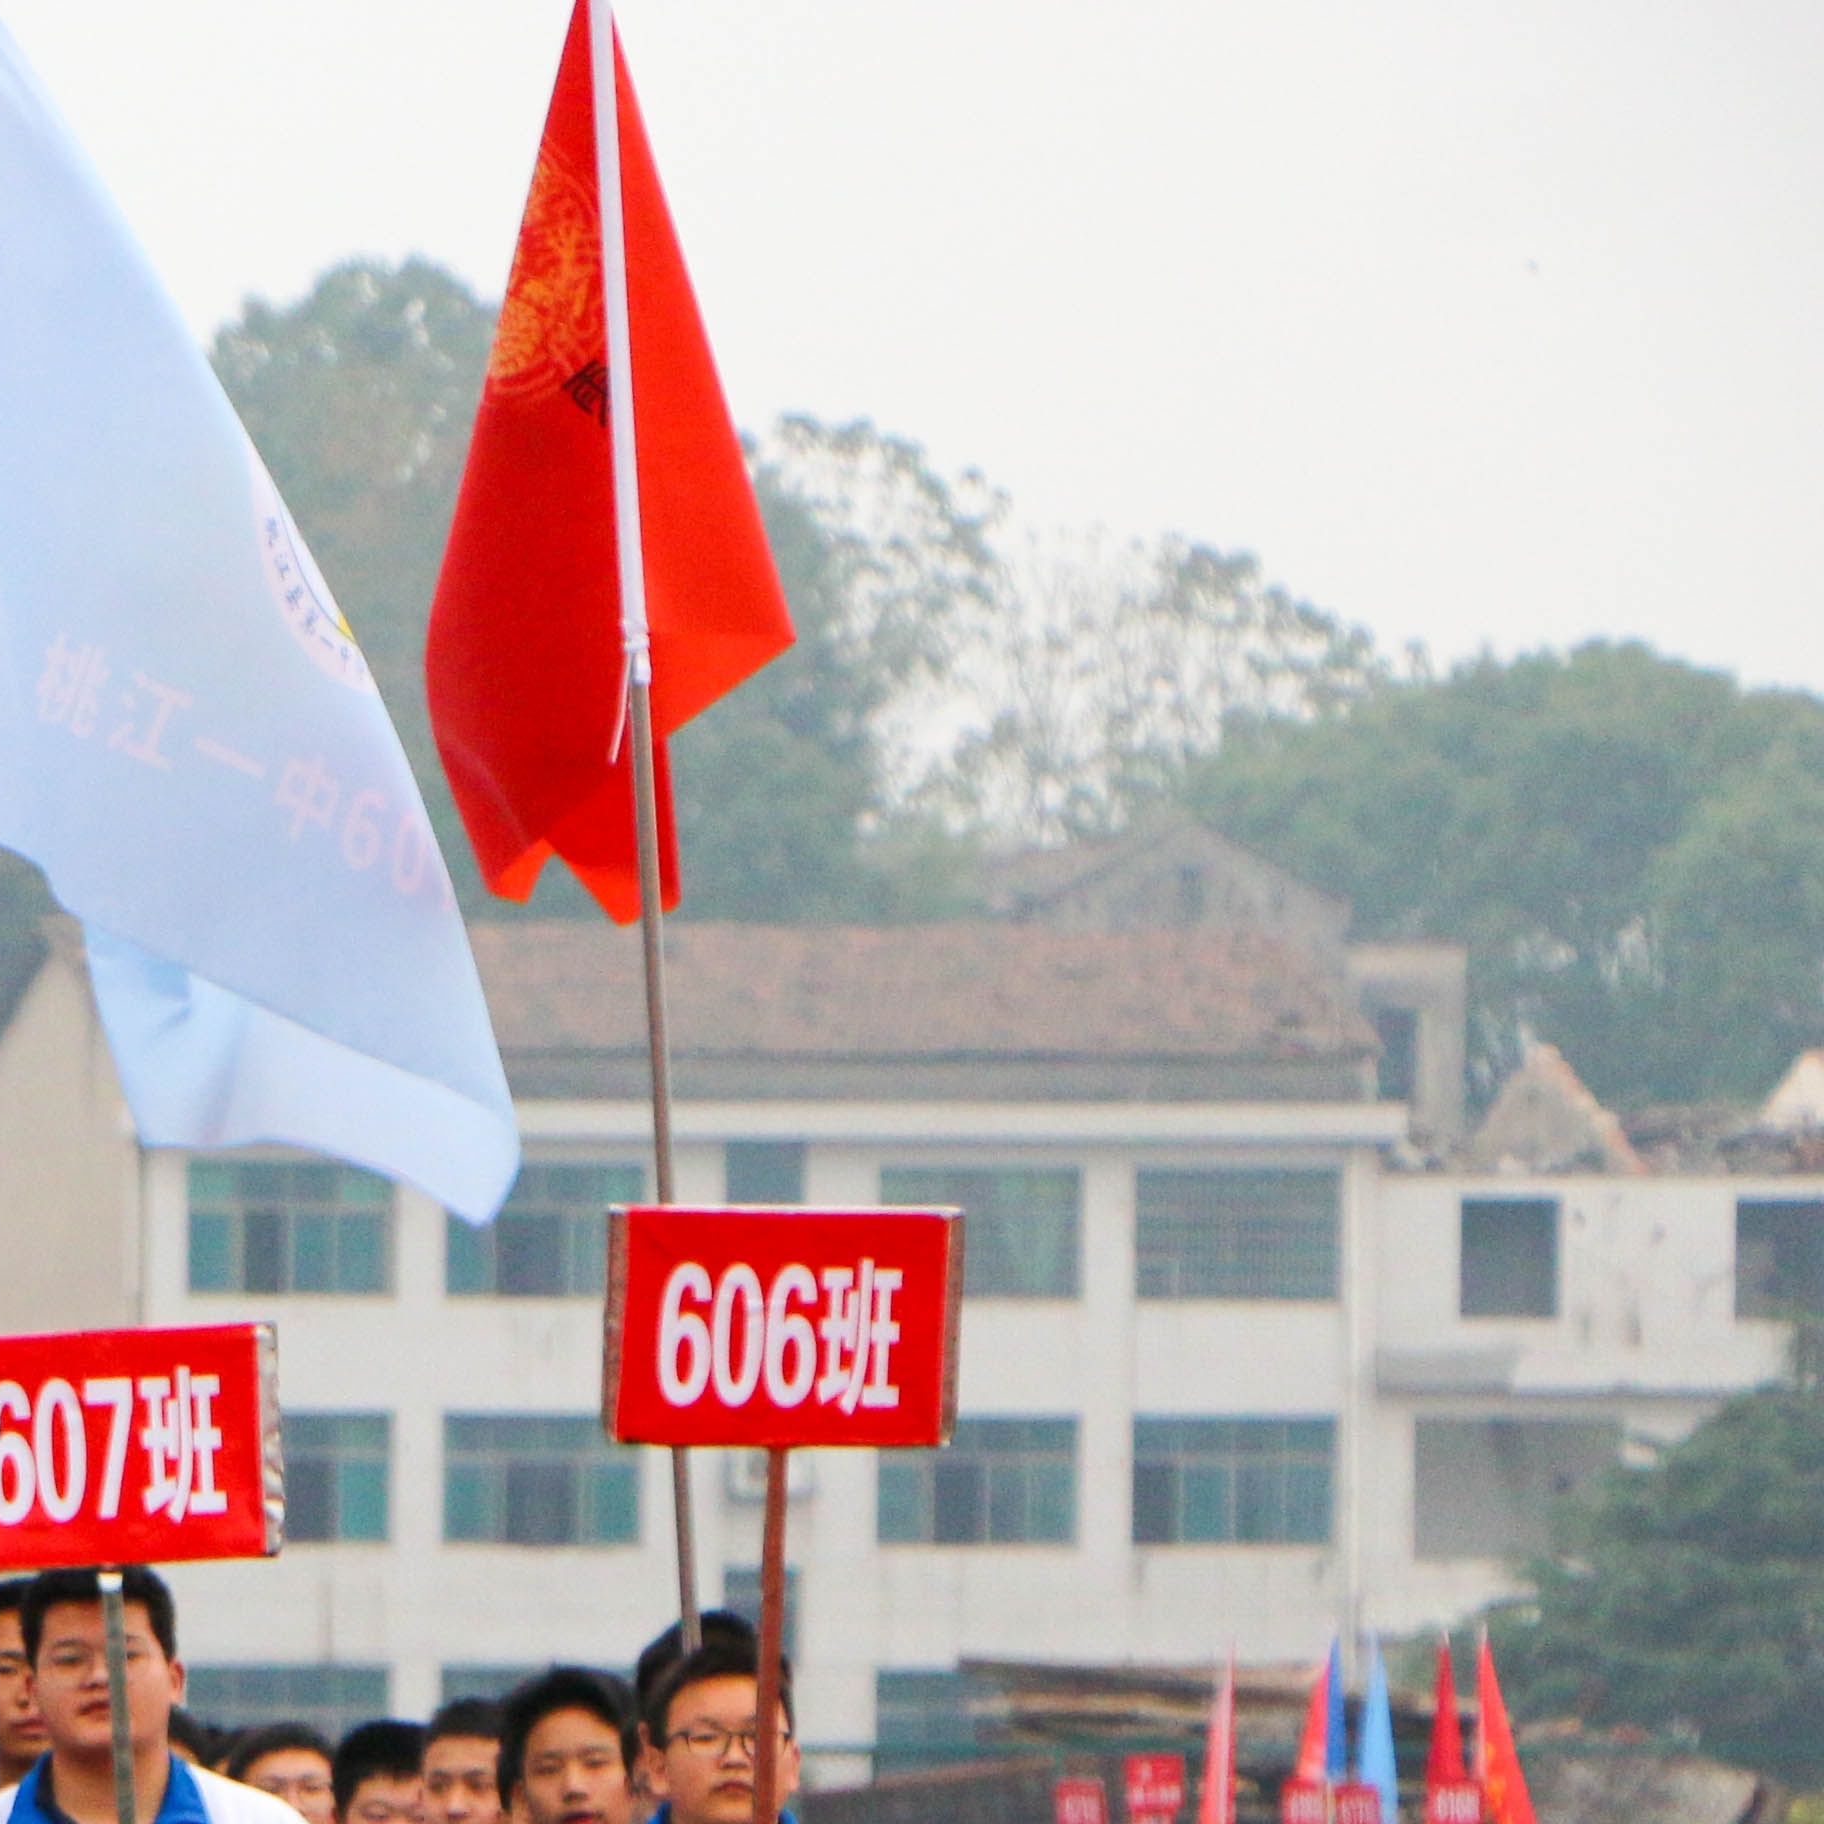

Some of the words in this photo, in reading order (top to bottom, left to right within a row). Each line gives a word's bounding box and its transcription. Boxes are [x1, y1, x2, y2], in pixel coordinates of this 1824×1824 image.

[36, 631, 457, 912] 桃江一中60
[656, 1258, 903, 1414] 606班
